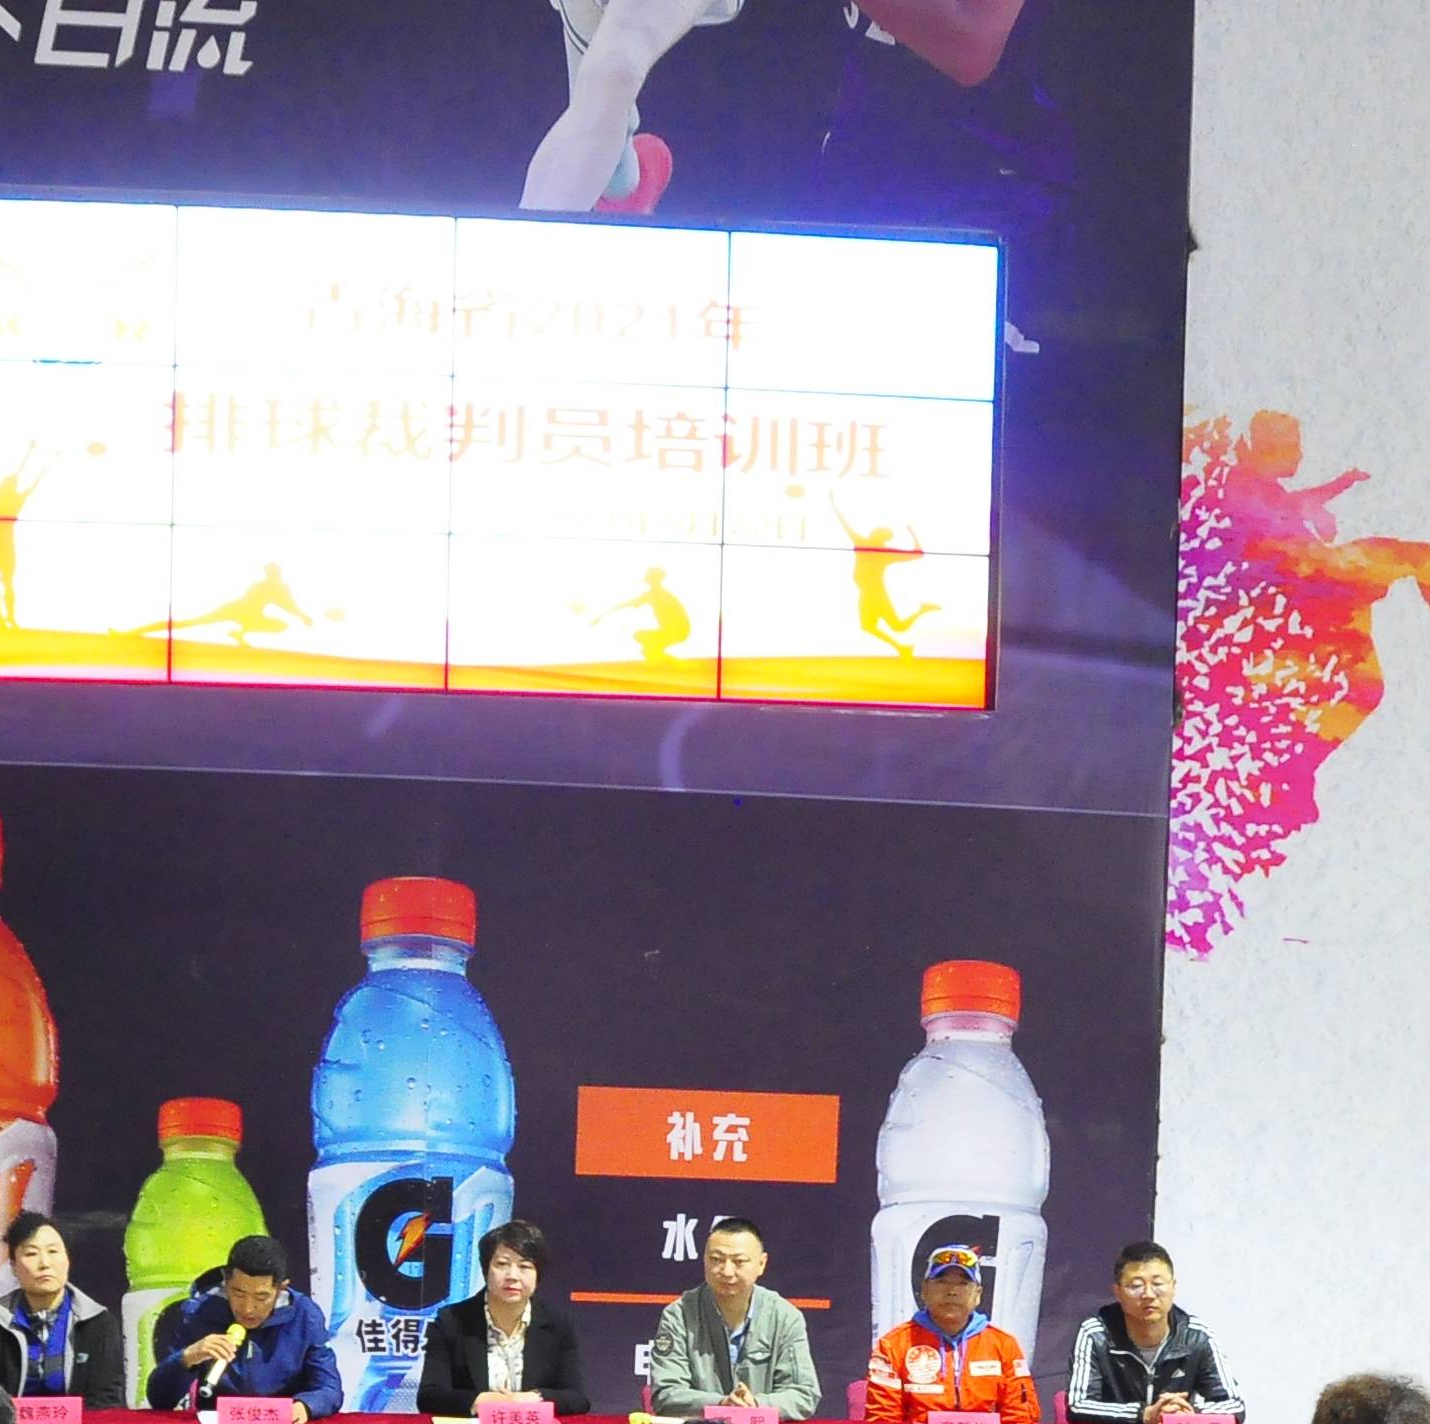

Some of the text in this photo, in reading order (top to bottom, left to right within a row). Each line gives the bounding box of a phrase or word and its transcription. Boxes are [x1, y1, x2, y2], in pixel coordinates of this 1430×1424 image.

[164, 392, 889, 478] 排球裁判员培训班
[666, 1111, 750, 1162] 补充
[355, 1319, 439, 1355] 佳得
[229, 1405, 280, 1421] 张俊杰
